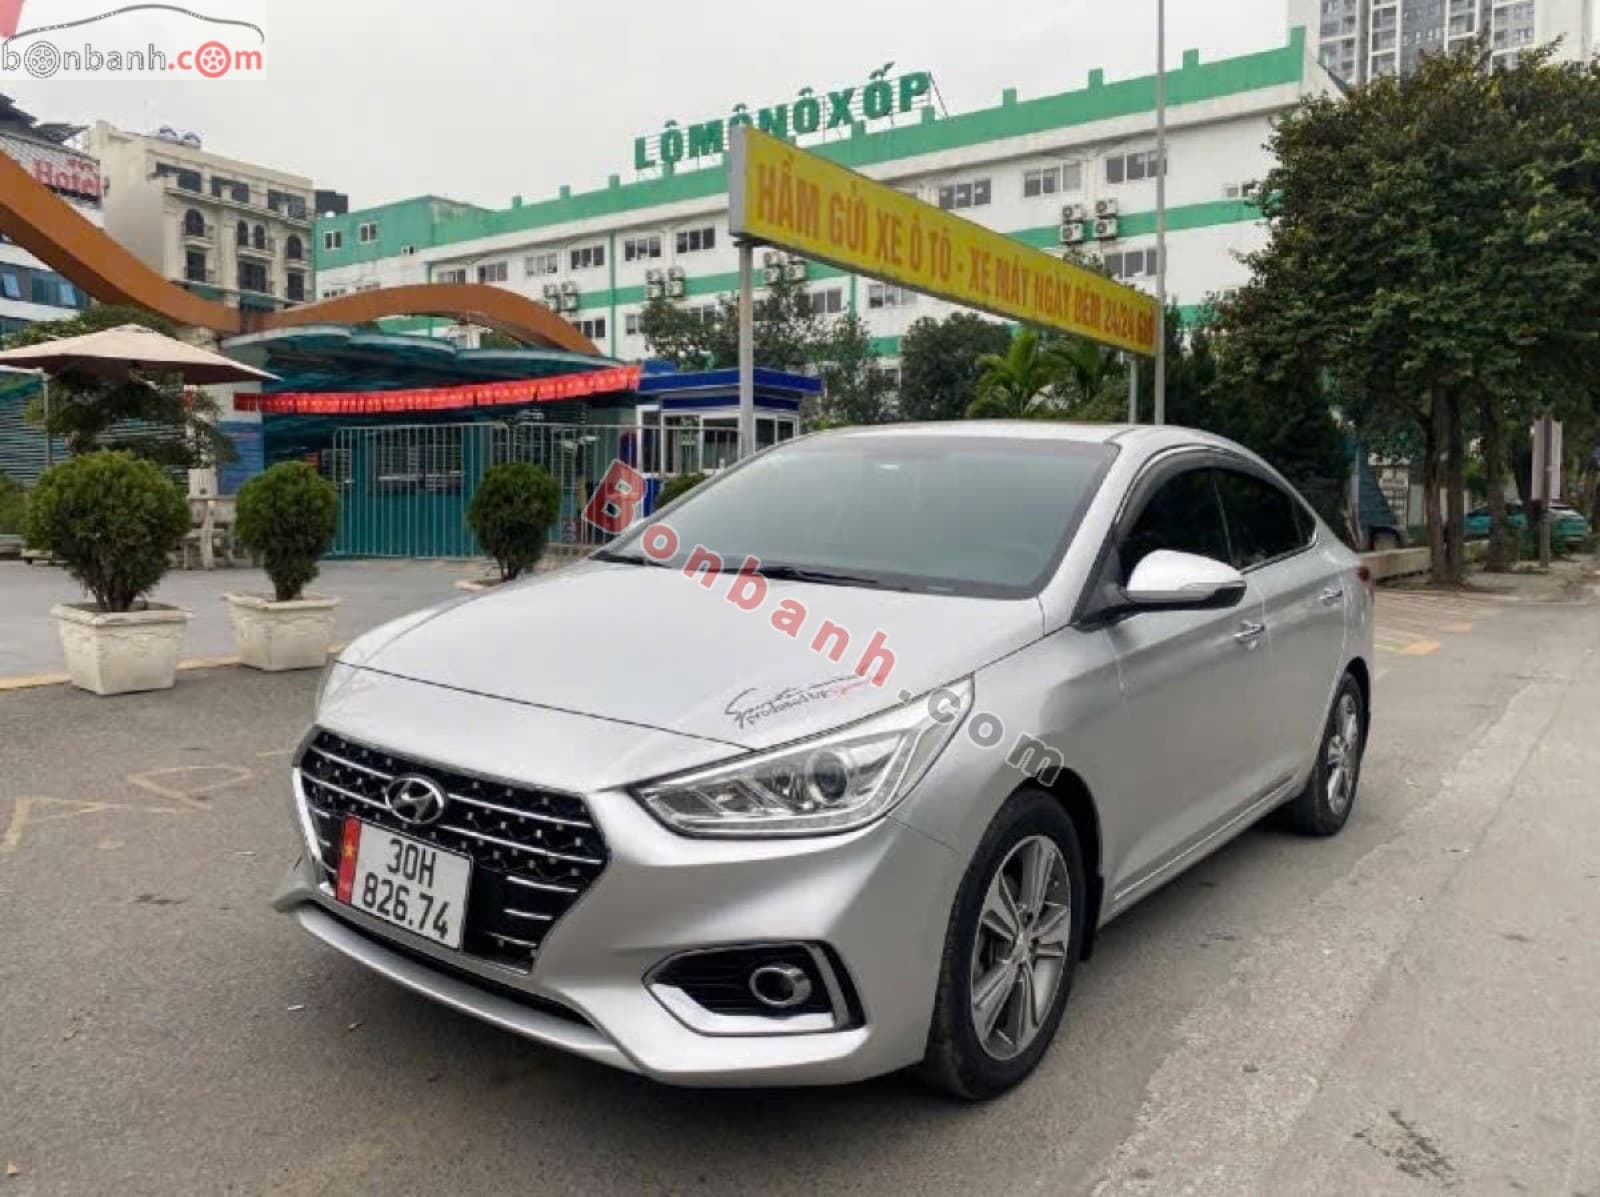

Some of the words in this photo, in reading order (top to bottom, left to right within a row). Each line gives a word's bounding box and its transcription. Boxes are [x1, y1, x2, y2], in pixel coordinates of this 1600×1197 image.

[756, 152, 821, 240] HẦM
[876, 206, 903, 266] XE
[909, 212, 923, 273] Ô
[928, 225, 953, 282] TÔ
[969, 247, 991, 296] XE
[995, 254, 1029, 305] MÁY
[386, 837, 436, 889] 30H
[362, 871, 449, 940] 826.74
